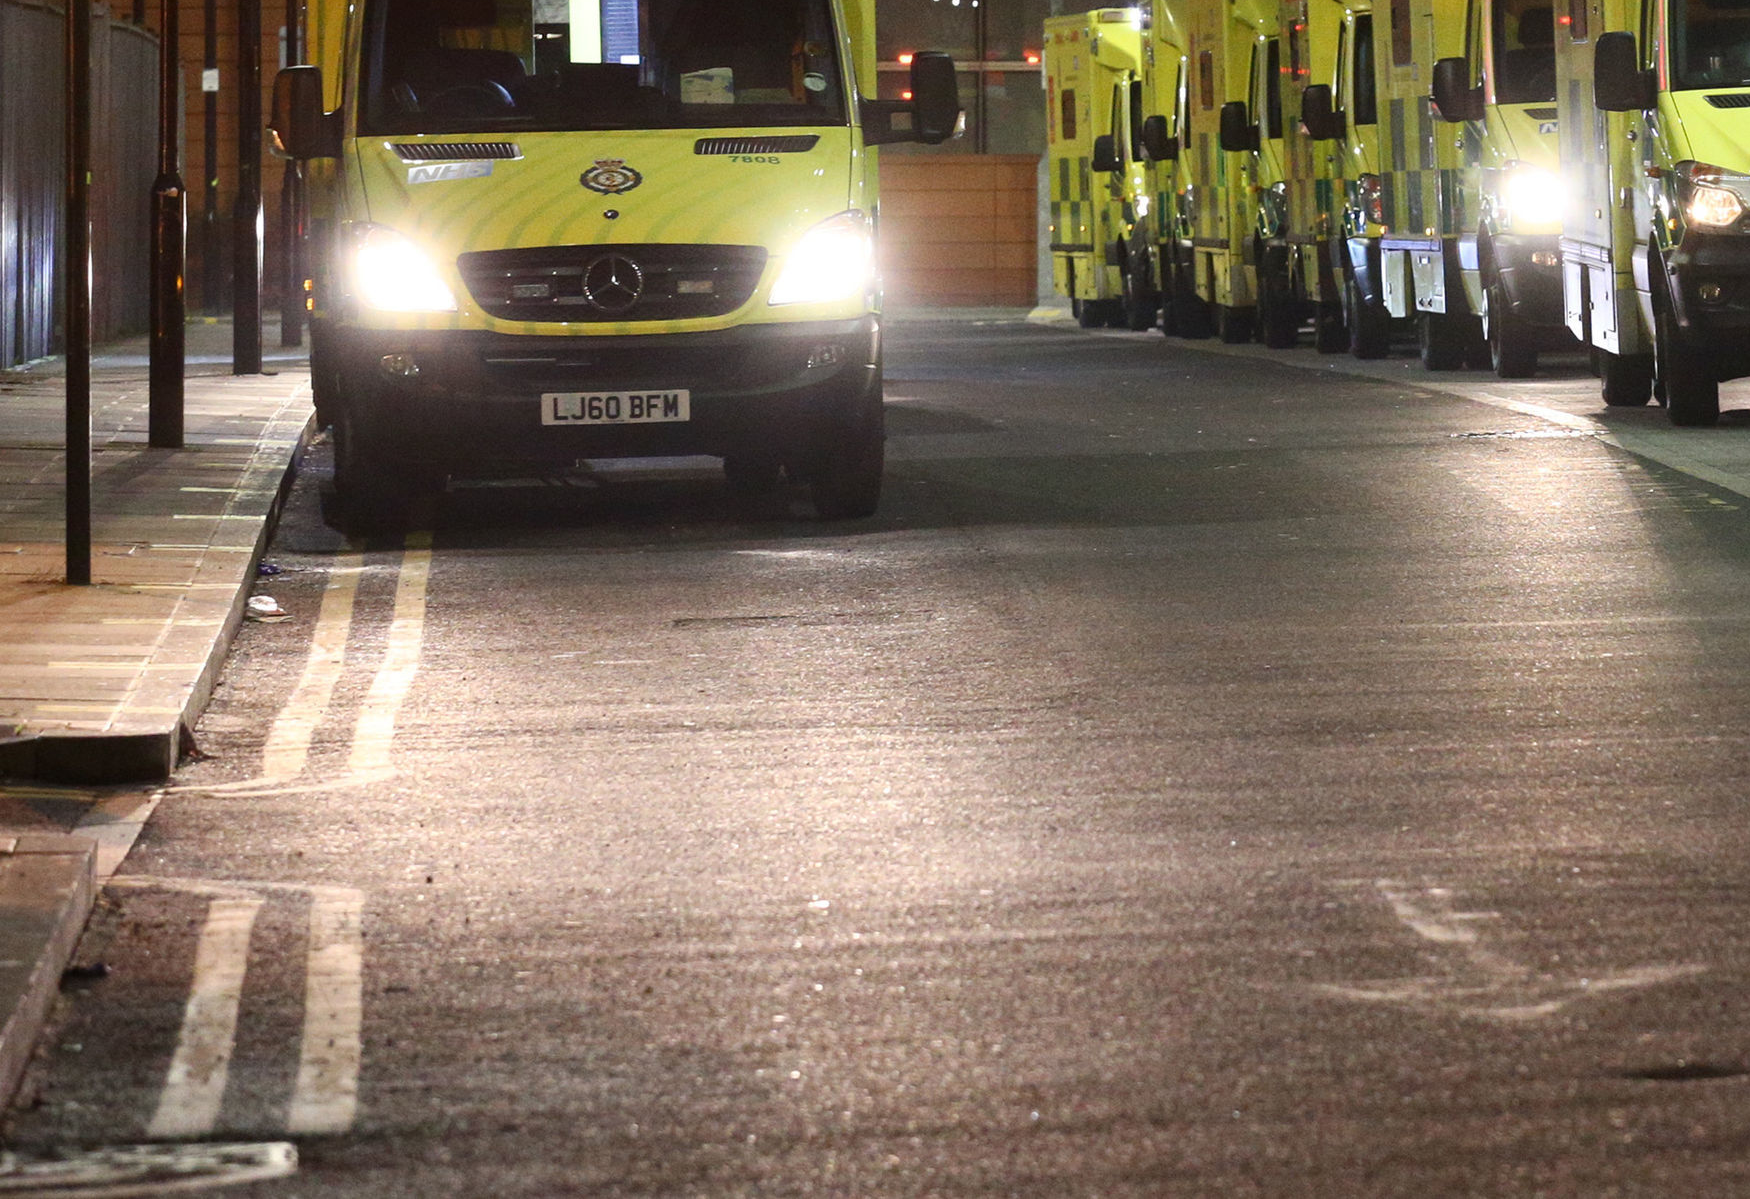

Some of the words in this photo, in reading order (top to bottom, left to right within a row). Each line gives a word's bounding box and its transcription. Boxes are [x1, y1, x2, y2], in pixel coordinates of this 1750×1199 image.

[728, 155, 781, 165] 7808
[553, 395, 621, 421] LJ60
[629, 394, 679, 419] BFM
